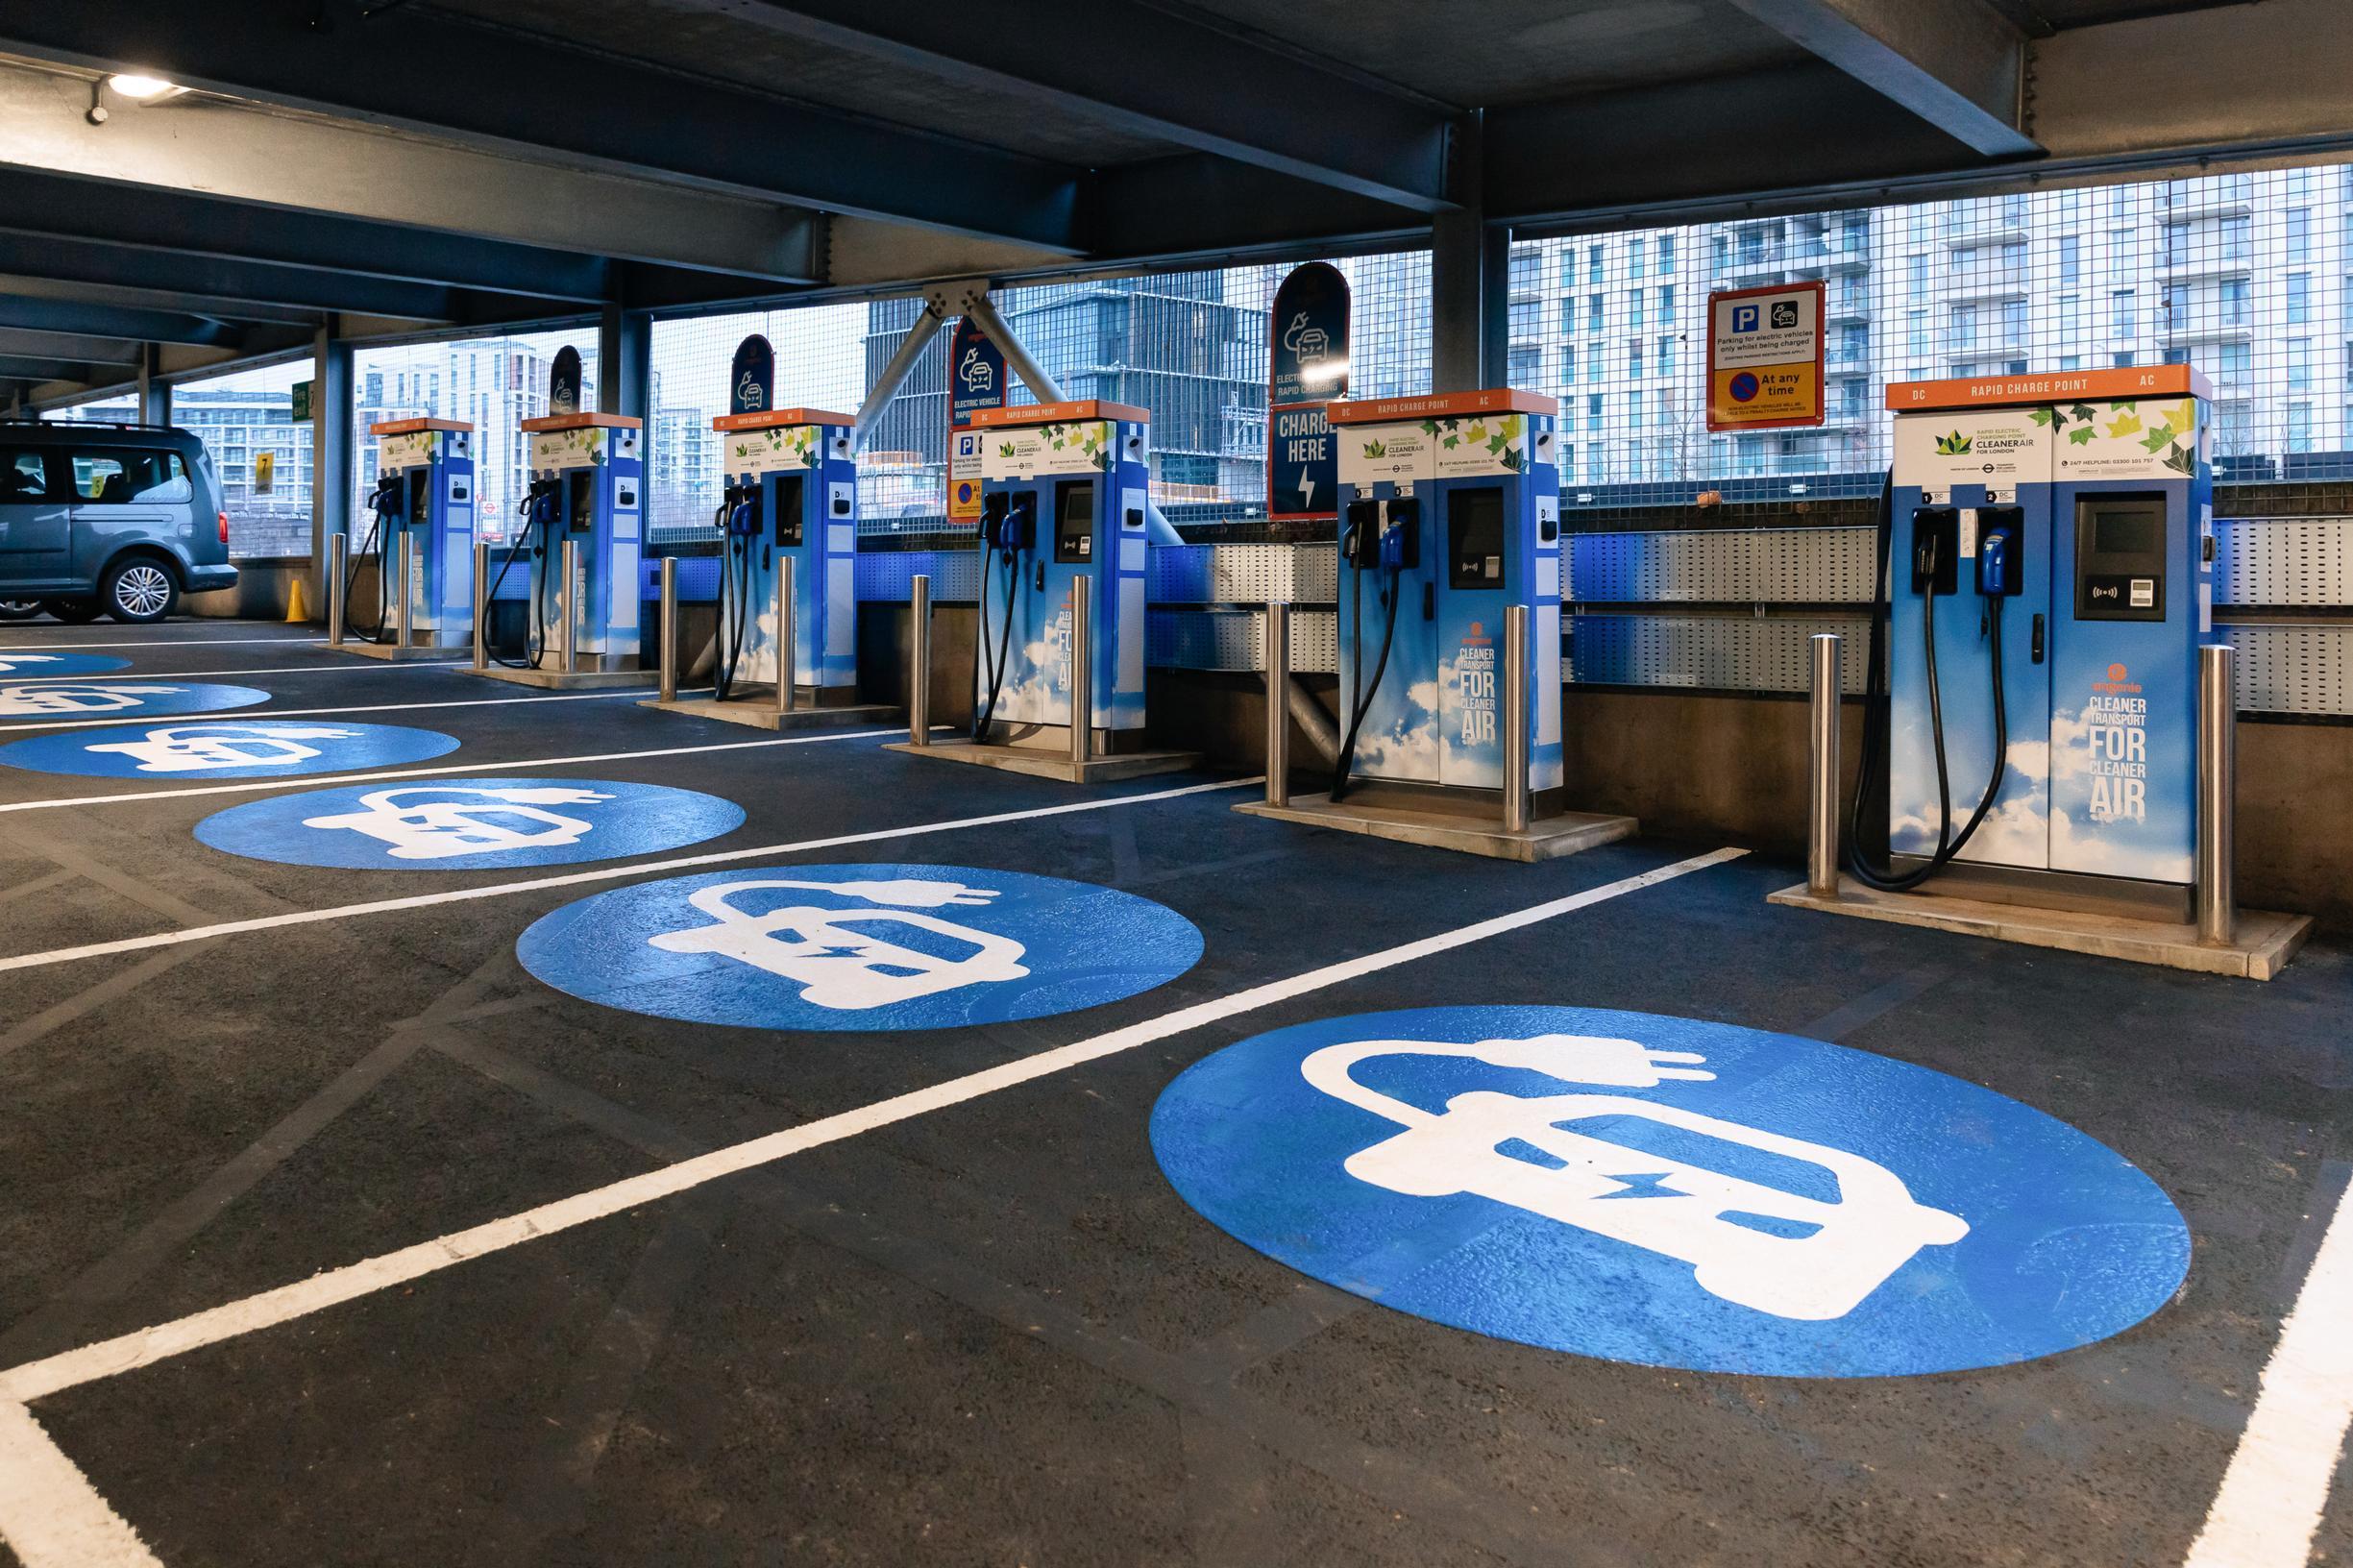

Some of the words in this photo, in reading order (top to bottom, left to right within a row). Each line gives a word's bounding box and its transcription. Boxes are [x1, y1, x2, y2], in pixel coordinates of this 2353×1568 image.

[1739, 309, 1754, 330] P
[1780, 338, 1809, 347] charged
[1761, 375, 1775, 384] At
[1779, 374, 1800, 383] any
[2140, 375, 2154, 385] AC
[1278, 386, 1299, 396] RAPID
[1768, 387, 1794, 396] time
[1913, 390, 1925, 400] DC
[1972, 385, 2002, 397] RAPID
[2007, 381, 2049, 395] CHARGE
[2054, 380, 2088, 392] POINT
[954, 399, 978, 408] ELECTRIC
[979, 397, 1000, 405] VEHICLE
[1378, 404, 1397, 414] RAPID
[1400, 402, 1426, 412] CHARGE
[1429, 400, 1449, 409] POINT
[1480, 397, 1488, 405] AC
[1042, 407, 1056, 416] POINT
[964, 439, 971, 453] P
[1288, 438, 1326, 462] HERE
[262, 458, 267, 476] 7
[1460, 648, 1494, 659] CLEANER
[1460, 661, 1494, 670] TRANSPORT
[1460, 671, 1495, 698] FOR
[1461, 698, 1495, 710] CLEANER
[2090, 697, 2146, 713] CLEANER
[1461, 710, 1495, 741] AIR
[2091, 712, 2145, 726] TRANSPORT
[2090, 725, 2145, 762] FOR
[2090, 761, 2145, 778] CLEANER
[2090, 776, 2145, 818] AIR
